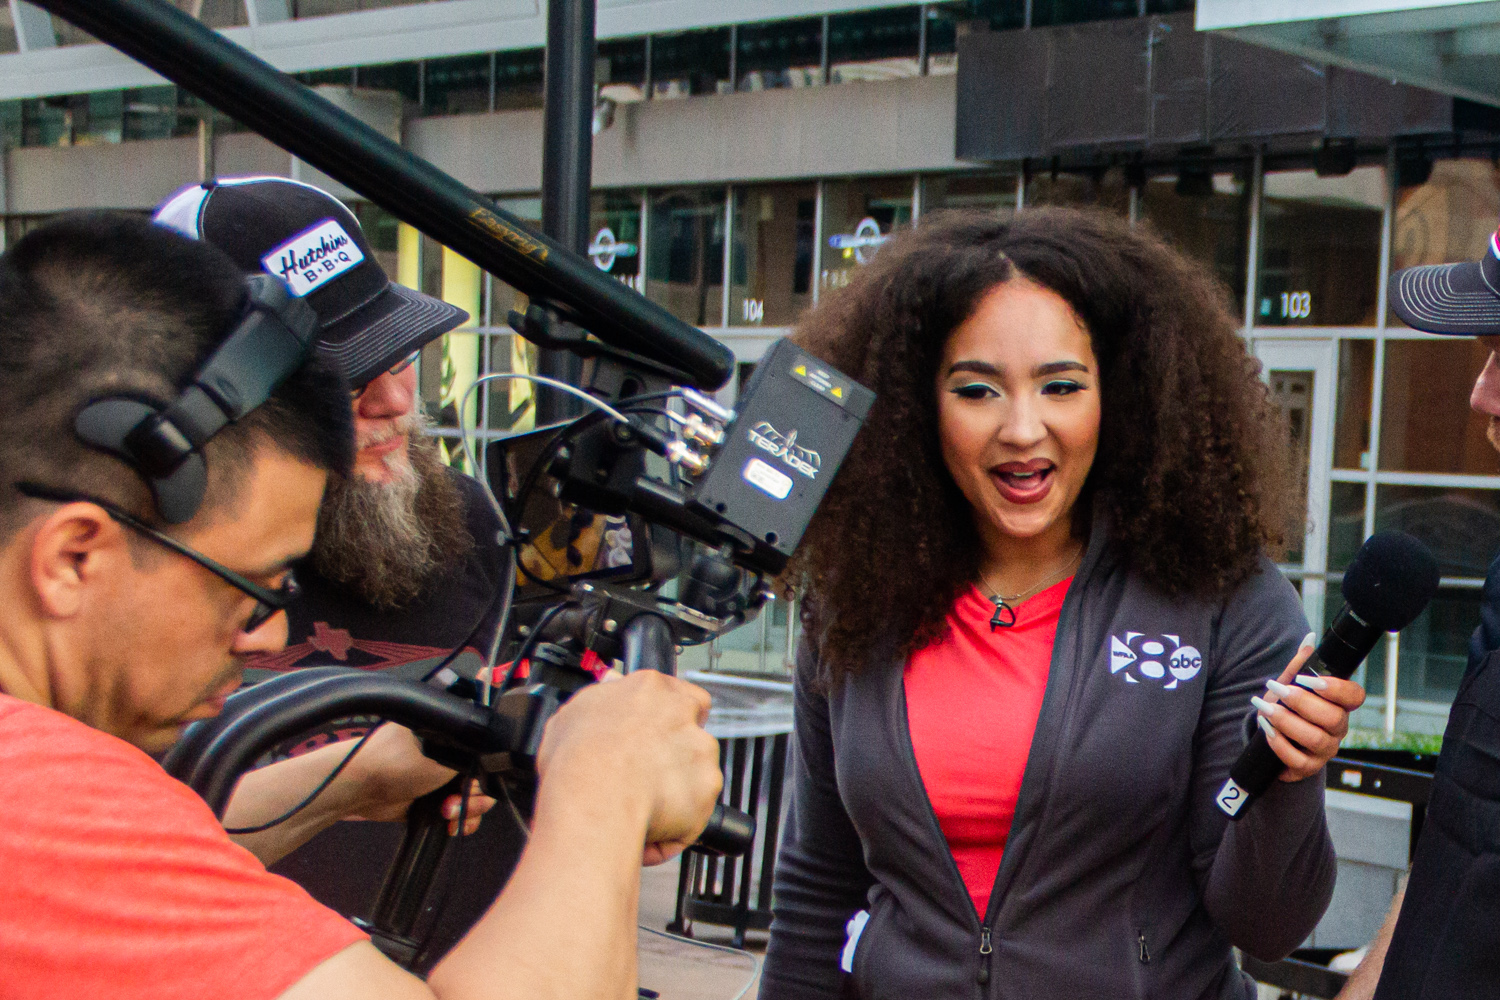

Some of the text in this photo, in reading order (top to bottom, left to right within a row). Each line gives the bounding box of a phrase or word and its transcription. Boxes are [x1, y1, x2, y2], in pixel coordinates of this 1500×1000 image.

[280, 234, 348, 281] Hutchins
[743, 299, 764, 321] 104
[1281, 291, 1311, 318] 103
[747, 429, 819, 480] TERADEK
[1169, 654, 1201, 669] abc
[1222, 787, 1240, 809] 2
